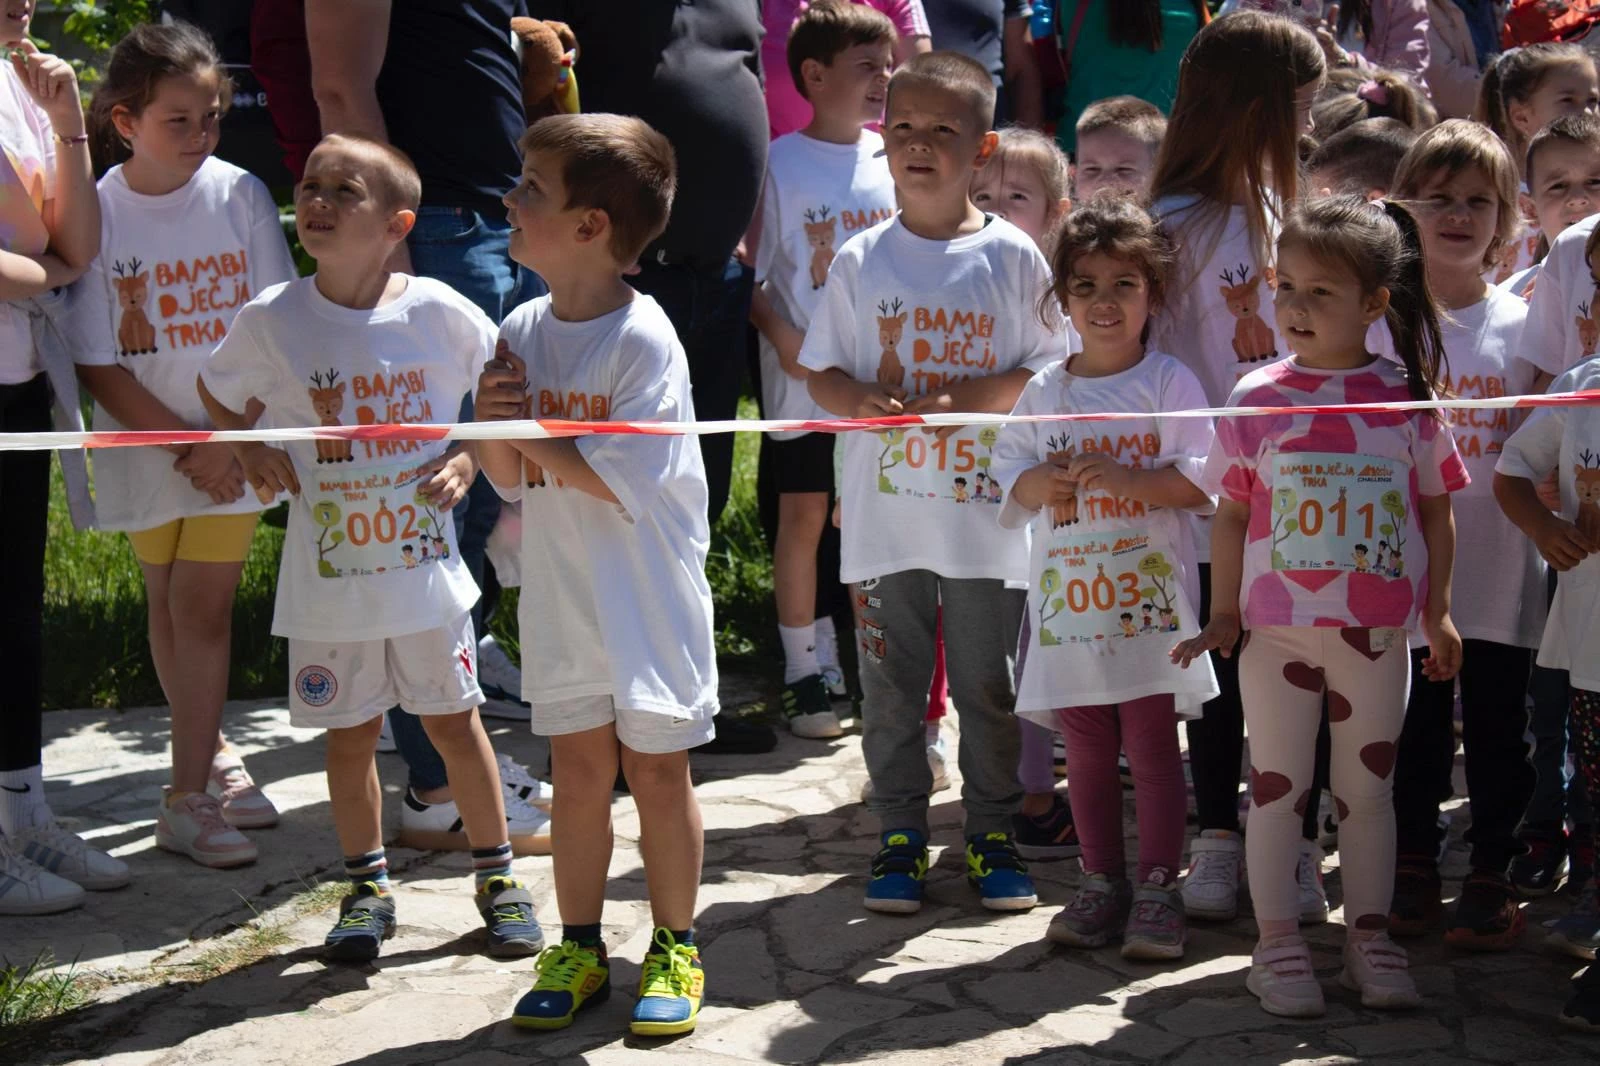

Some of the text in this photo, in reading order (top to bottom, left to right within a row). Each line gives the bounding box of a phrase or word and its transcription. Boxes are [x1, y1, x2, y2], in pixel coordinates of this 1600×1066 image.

[156, 249, 247, 288] BAMBI
[164, 317, 227, 350] TRKA
[352, 368, 426, 399] BAMBI
[911, 368, 970, 395] TRK
[905, 436, 976, 473] 015
[1081, 433, 1161, 458] BAMB
[346, 504, 420, 547] 002
[1086, 495, 1146, 521] TRKA
[1298, 498, 1374, 540] 011
[1066, 571, 1142, 614] 003
